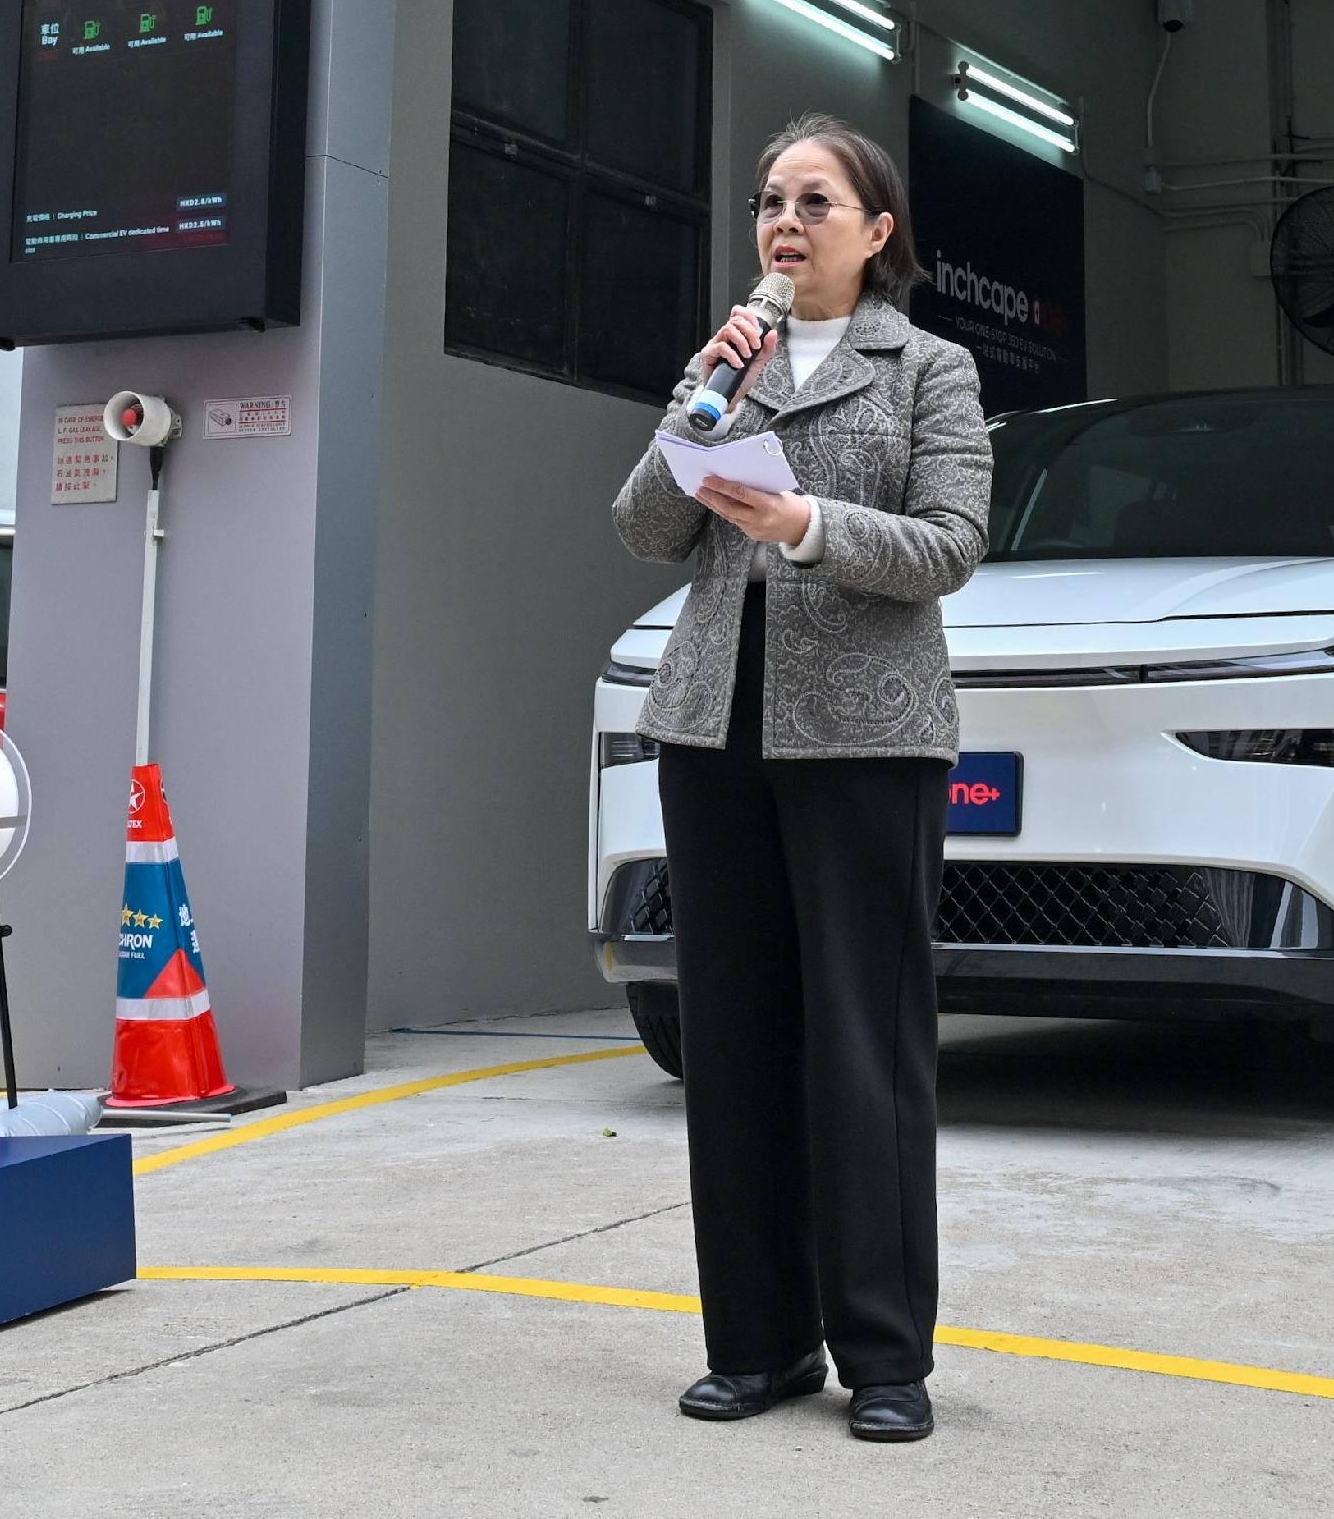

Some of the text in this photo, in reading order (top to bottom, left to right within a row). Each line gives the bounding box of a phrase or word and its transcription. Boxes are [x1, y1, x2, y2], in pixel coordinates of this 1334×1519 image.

[41, 34, 58, 46] Bay
[936, 249, 1029, 326] inchcape
[949, 782, 1000, 805] ne+
